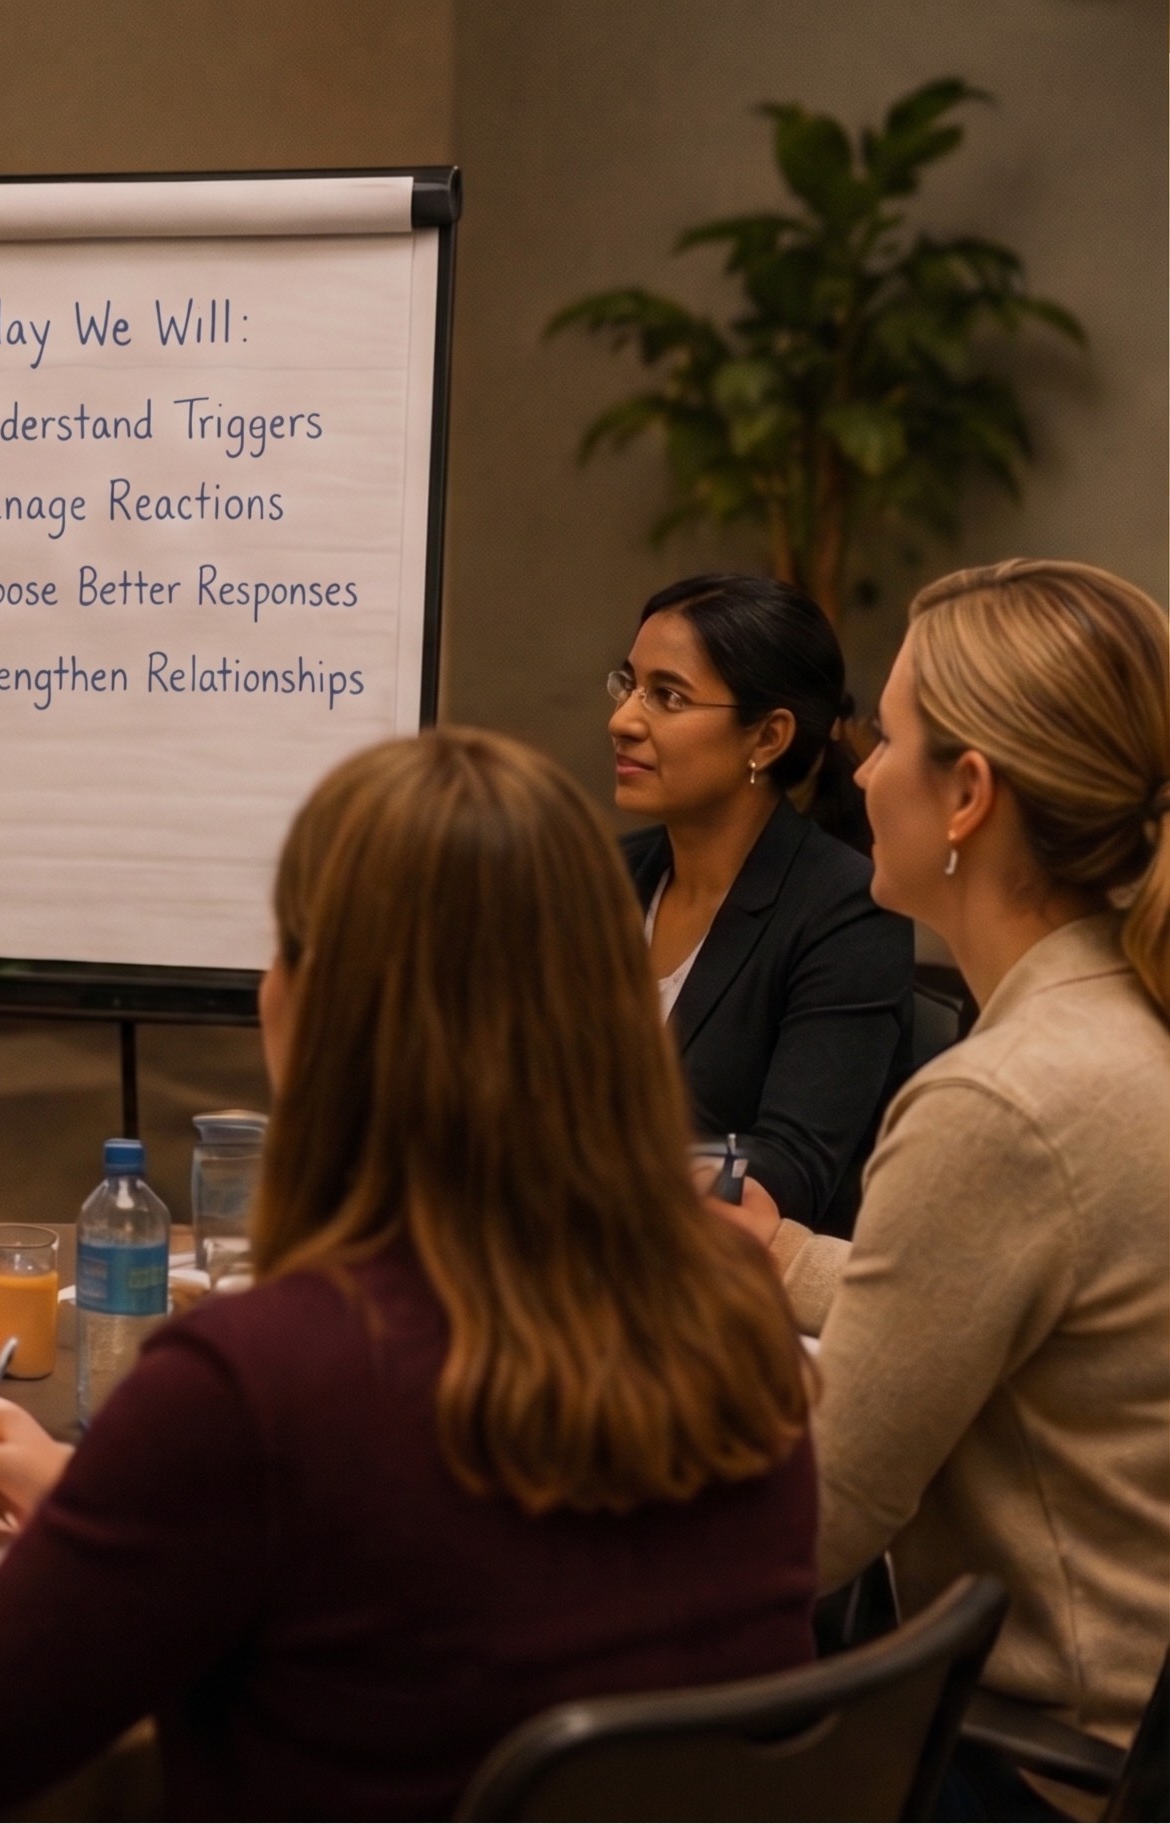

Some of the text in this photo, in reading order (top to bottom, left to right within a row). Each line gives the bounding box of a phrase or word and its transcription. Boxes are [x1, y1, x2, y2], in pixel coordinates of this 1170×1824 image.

[74, 299, 132, 347] We
[154, 297, 248, 347] Will:
[173, 396, 323, 459] Triggers
[109, 477, 284, 522] Reactions
[78, 564, 182, 607] Better
[198, 563, 358, 624] Responses
[147, 650, 365, 711] Relationships
